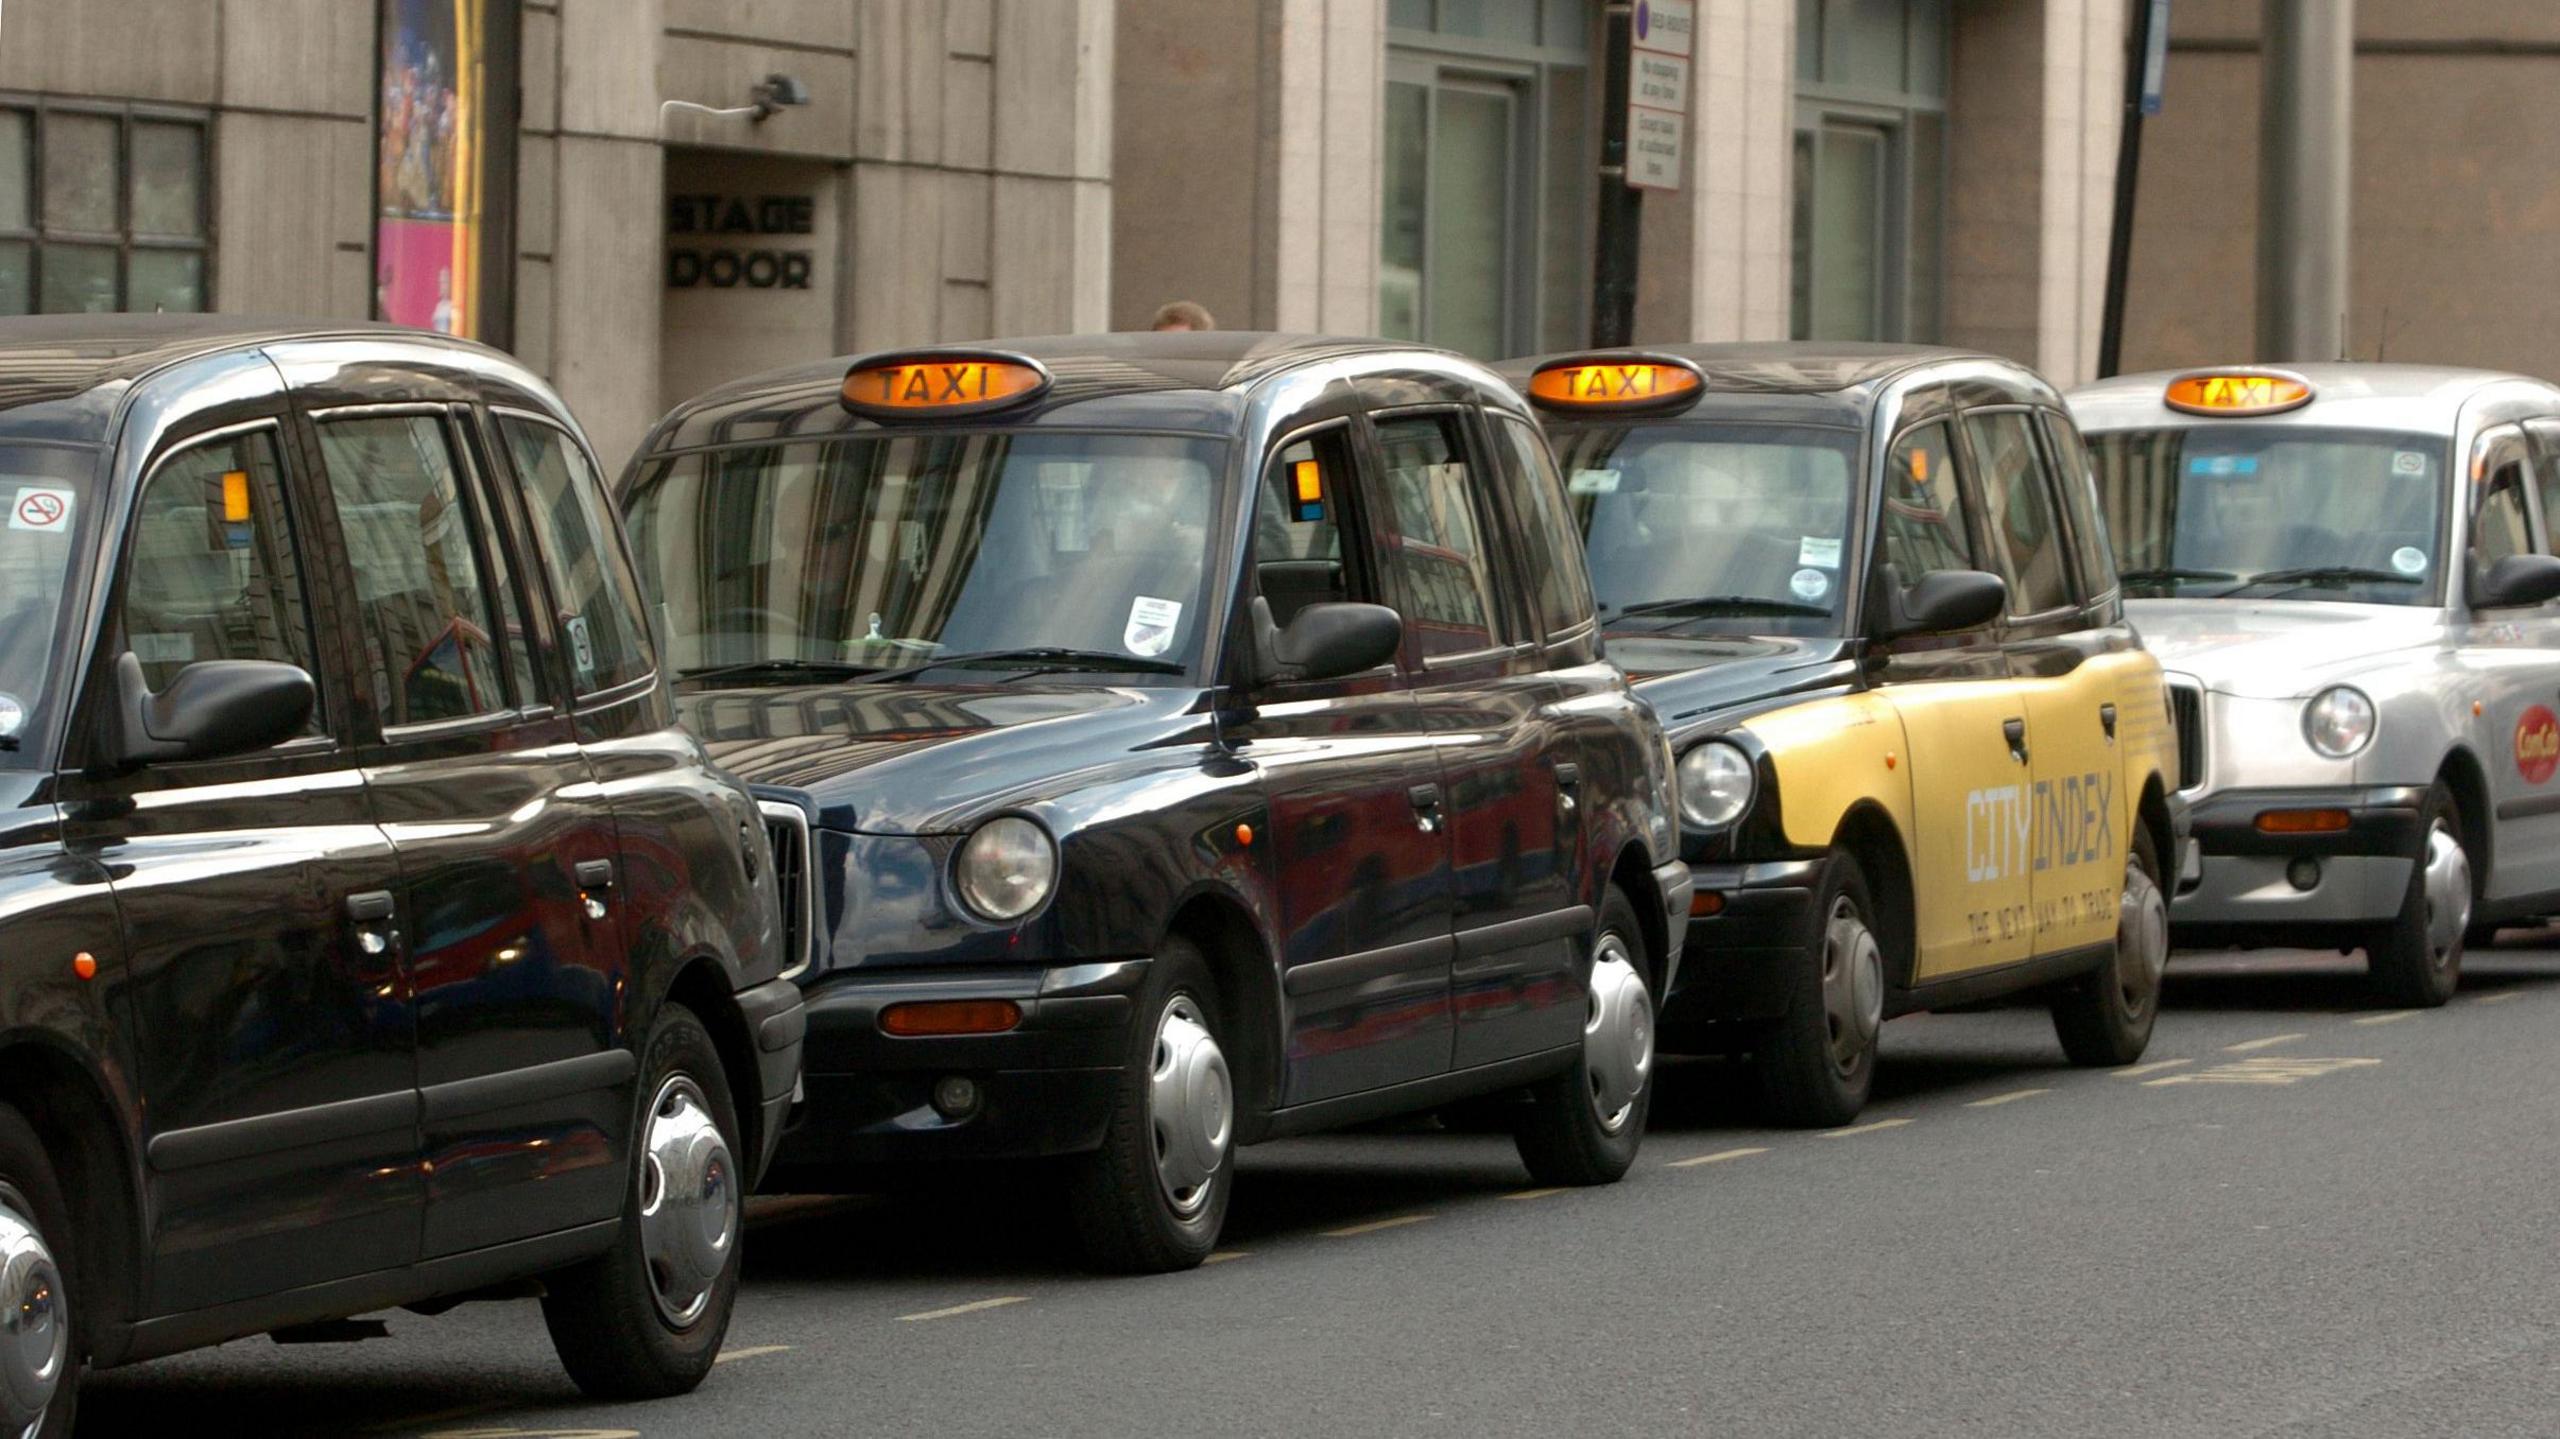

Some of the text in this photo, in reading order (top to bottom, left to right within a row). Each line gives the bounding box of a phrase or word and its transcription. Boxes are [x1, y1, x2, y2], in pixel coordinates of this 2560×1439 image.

[670, 194, 813, 233] STAGE
[668, 250, 812, 289] DOOR
[878, 366, 988, 401] TAXI
[1563, 367, 1657, 396] TAXI
[2195, 380, 2274, 404] TAXI
[1967, 771, 2113, 883] CITY INDEX
[1968, 911, 1992, 946] THE
[1998, 905, 2026, 941] NEXT
[2062, 896, 2077, 926] TO
[2082, 888, 2113, 921] TRADE
